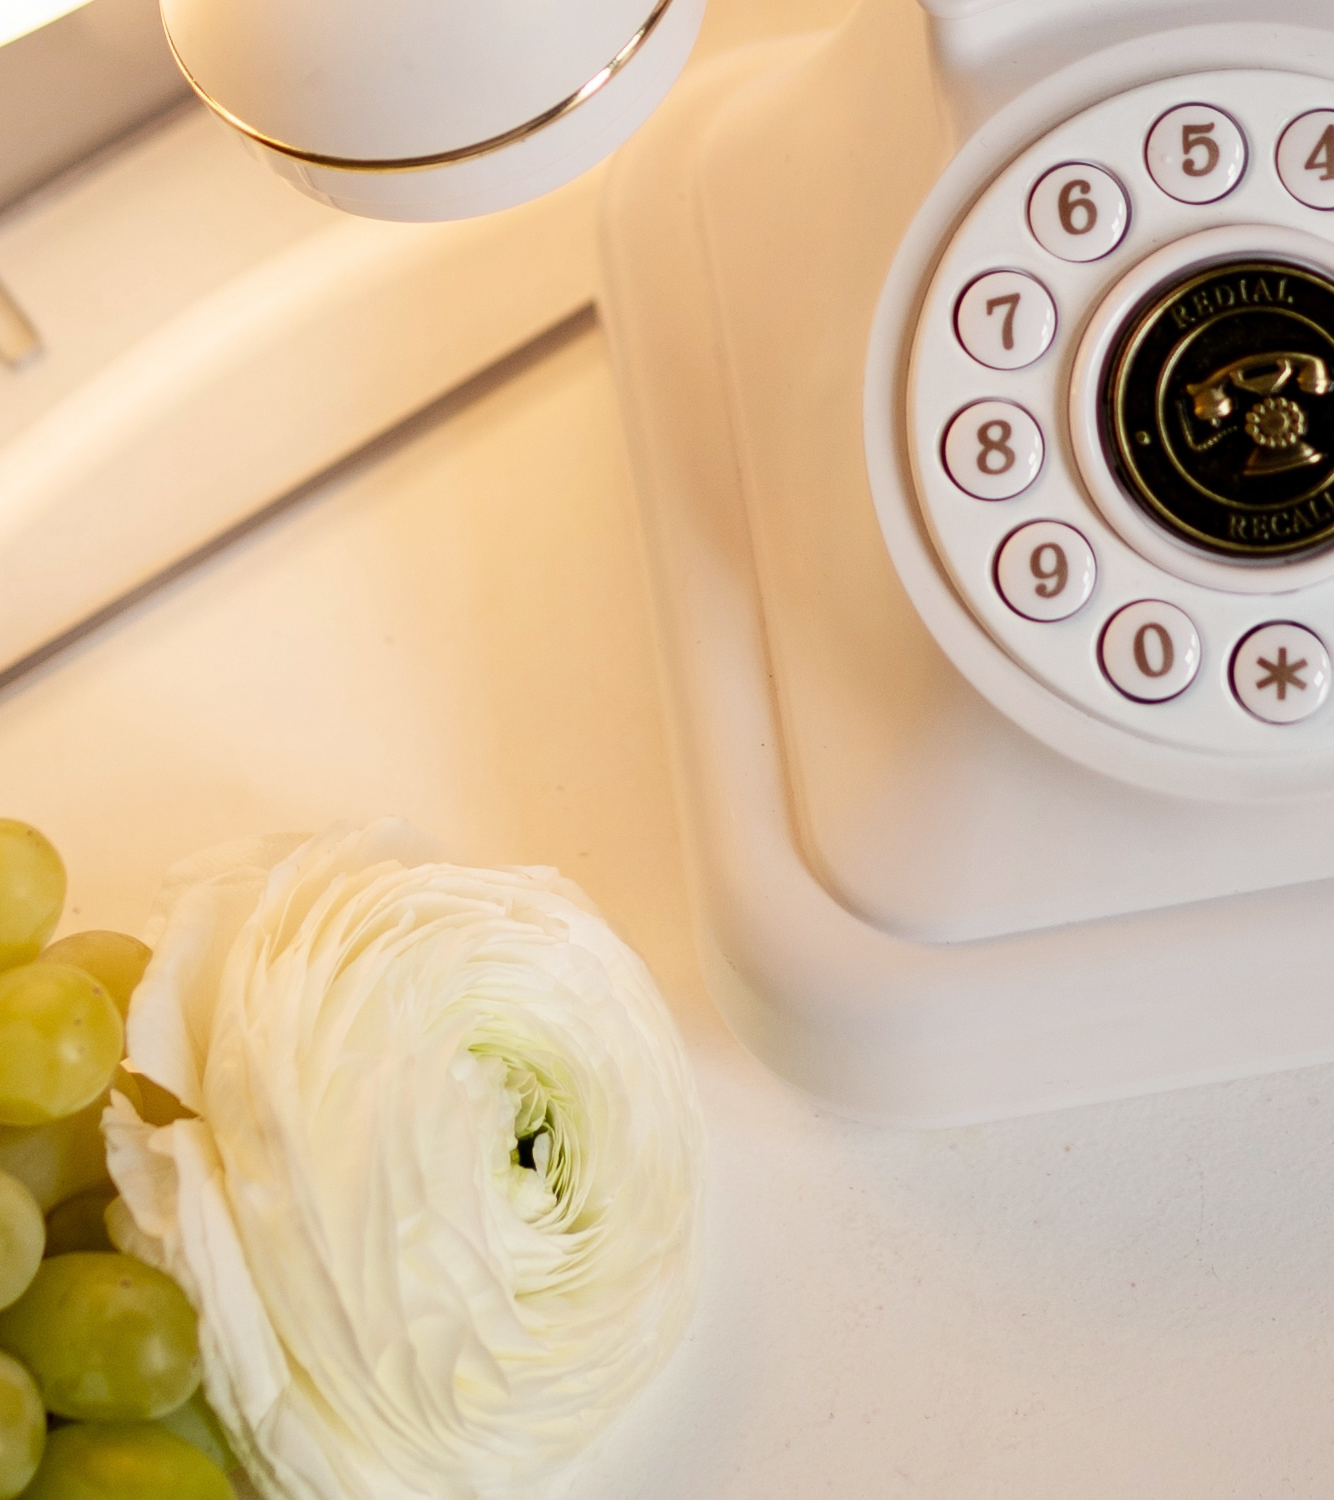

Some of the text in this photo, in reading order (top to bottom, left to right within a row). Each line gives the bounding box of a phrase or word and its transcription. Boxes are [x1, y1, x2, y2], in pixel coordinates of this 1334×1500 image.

[1182, 122, 1219, 177] 5
[1058, 179, 1097, 235] 6
[986, 293, 1020, 350] 7
[1171, 277, 1294, 328] REDIAL
[976, 420, 1015, 475] 8
[1030, 542, 1068, 599] 9
[1133, 622, 1174, 678] 0
